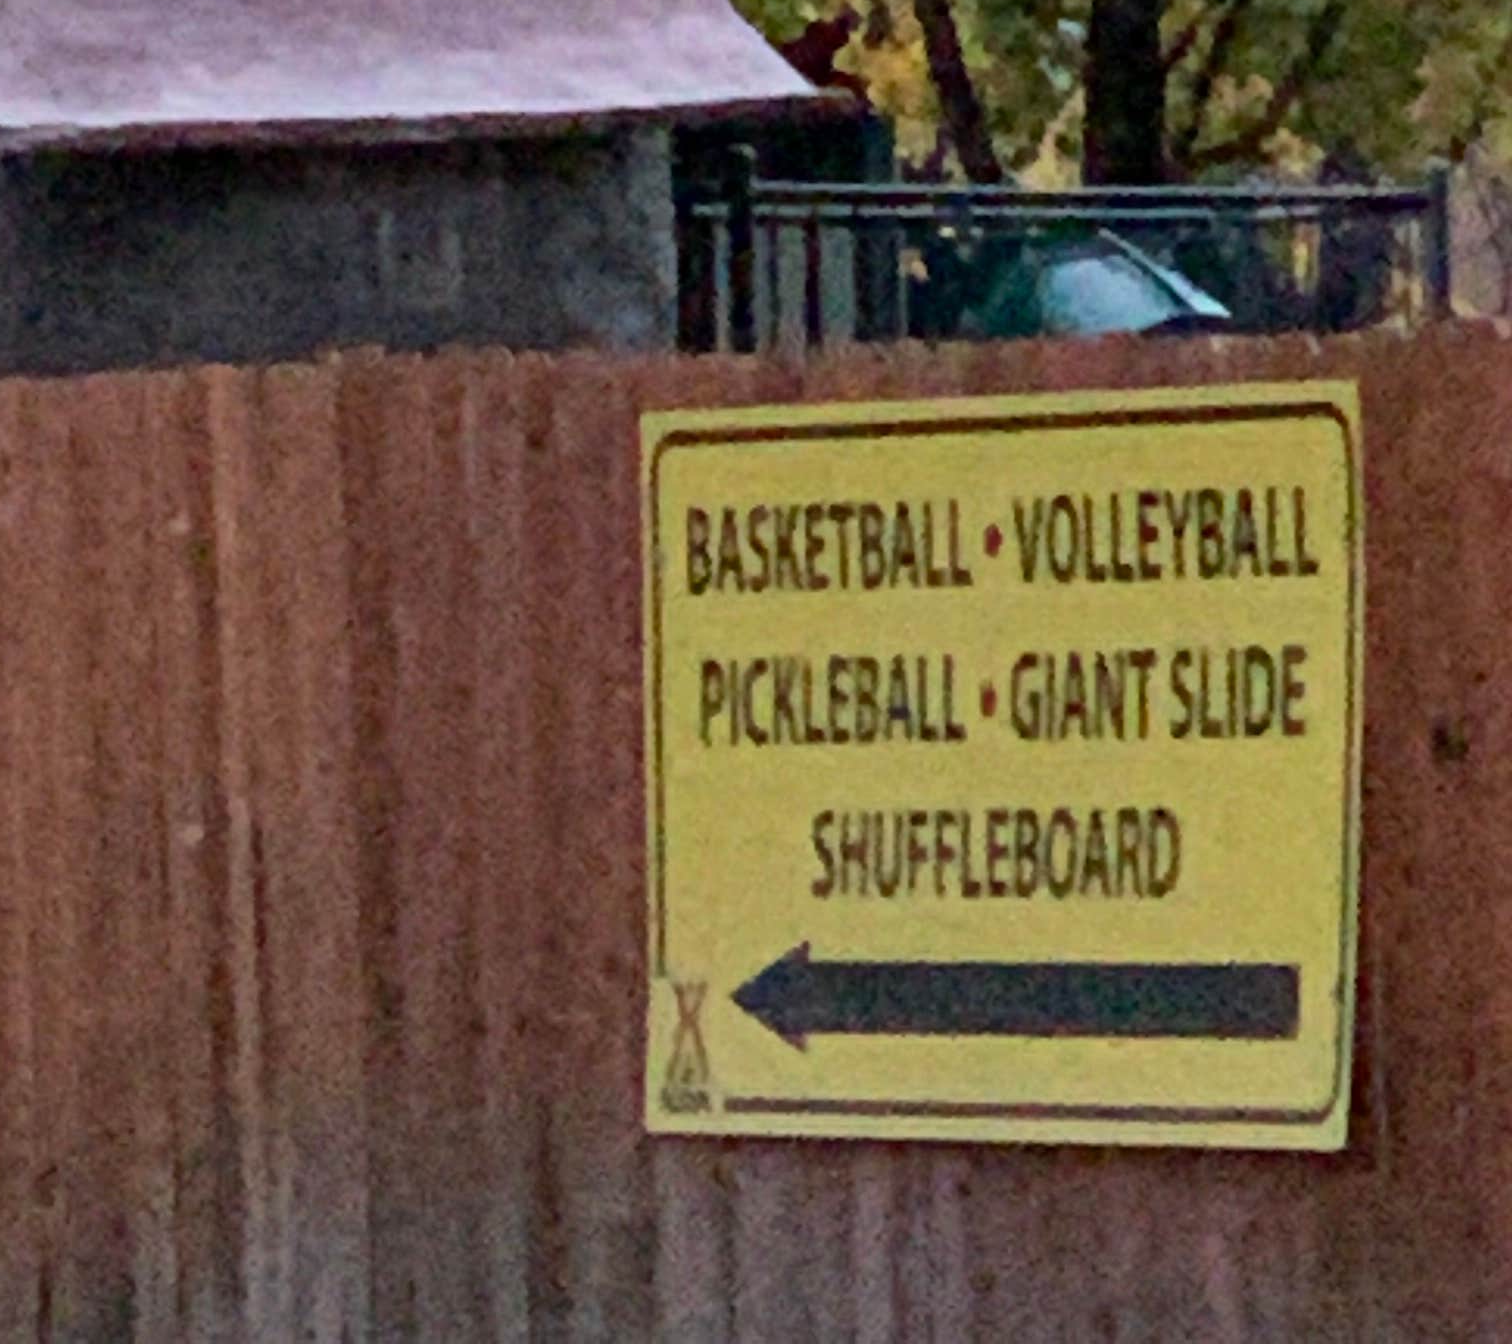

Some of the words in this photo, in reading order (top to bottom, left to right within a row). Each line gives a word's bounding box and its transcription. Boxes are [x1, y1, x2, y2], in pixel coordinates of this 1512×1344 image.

[686, 500, 972, 595] BASKETBALL
[1012, 486, 1319, 583] VOLLEYBALL
[700, 654, 966, 746] PICKLEBALL
[1009, 649, 1156, 740] GIANT
[1169, 645, 1306, 738] SLIDE
[810, 808, 1182, 898] SHUFFLEBOARD
